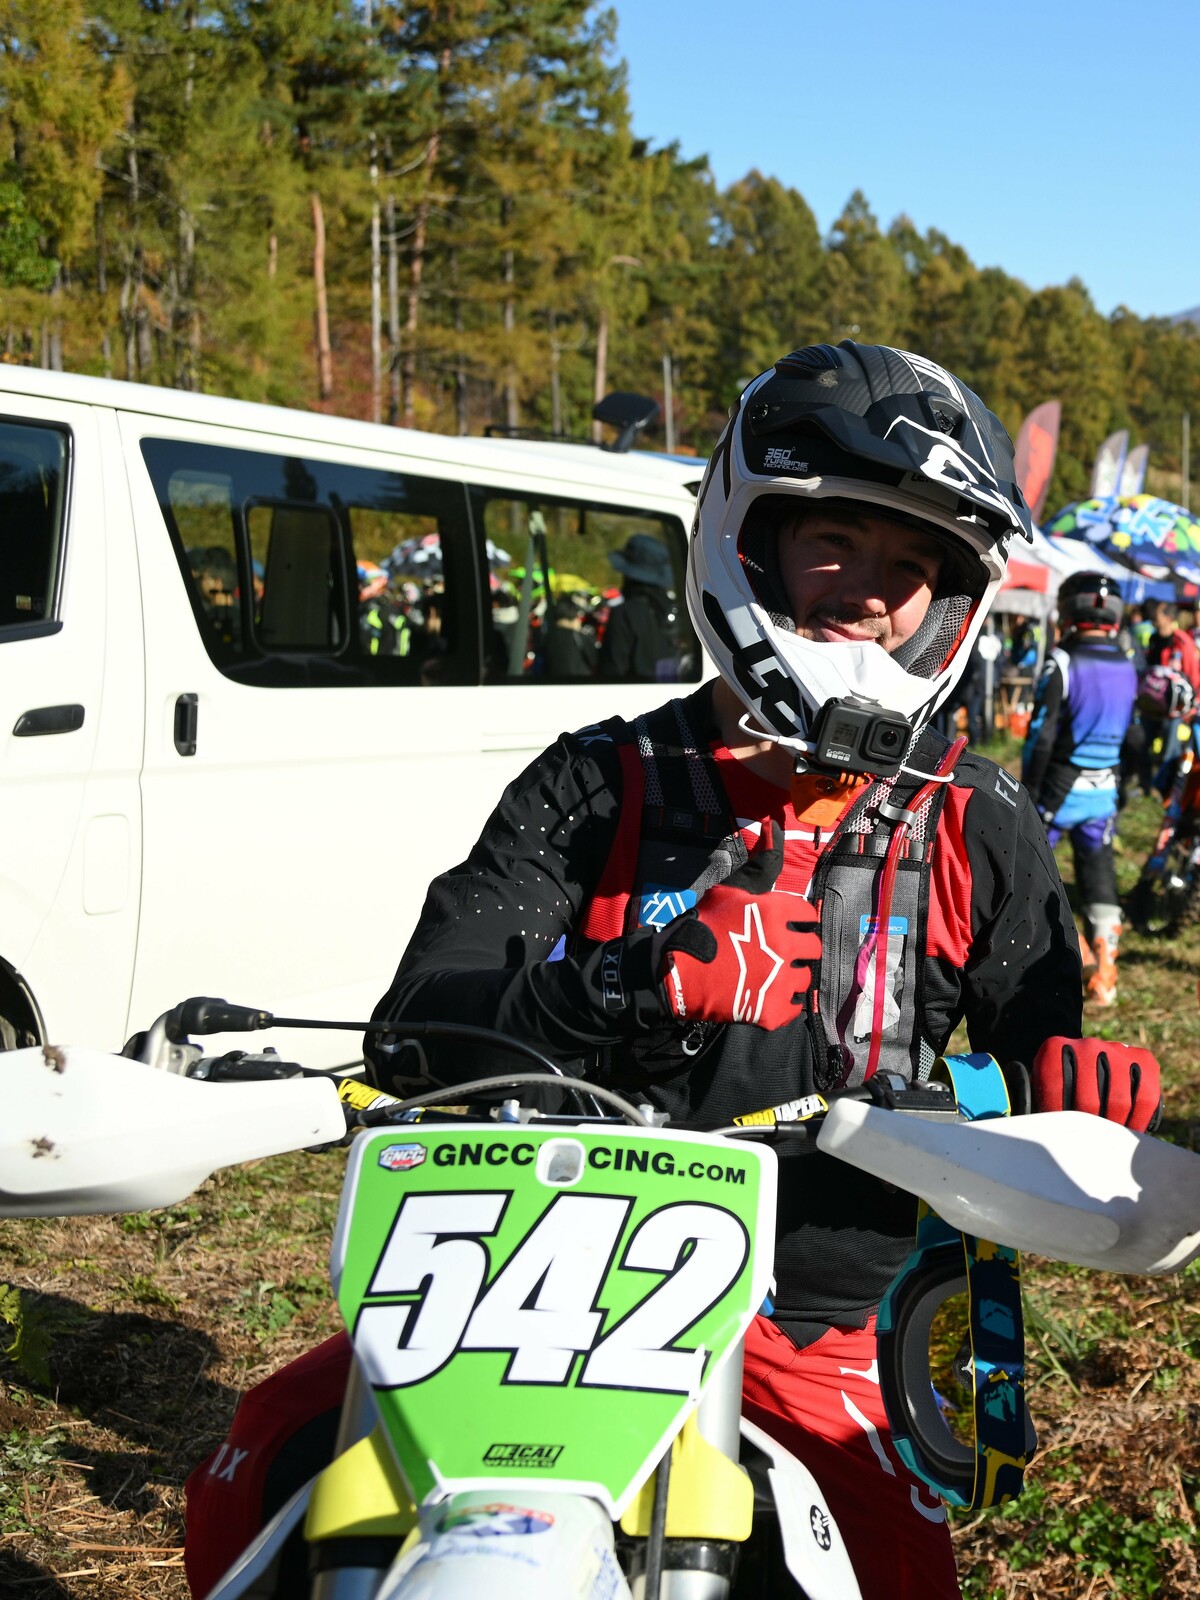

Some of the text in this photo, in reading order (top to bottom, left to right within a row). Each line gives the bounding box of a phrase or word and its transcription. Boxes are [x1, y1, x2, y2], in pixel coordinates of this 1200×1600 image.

[765, 458, 809, 469] TURBINE
[827, 748, 851, 758] GoPro
[994, 766, 1020, 807] FO
[604, 954, 621, 999] FOX
[433, 1142, 746, 1185] GNCCCING.COM
[353, 1189, 751, 1396] 542
[485, 1445, 561, 1460] DECAL
